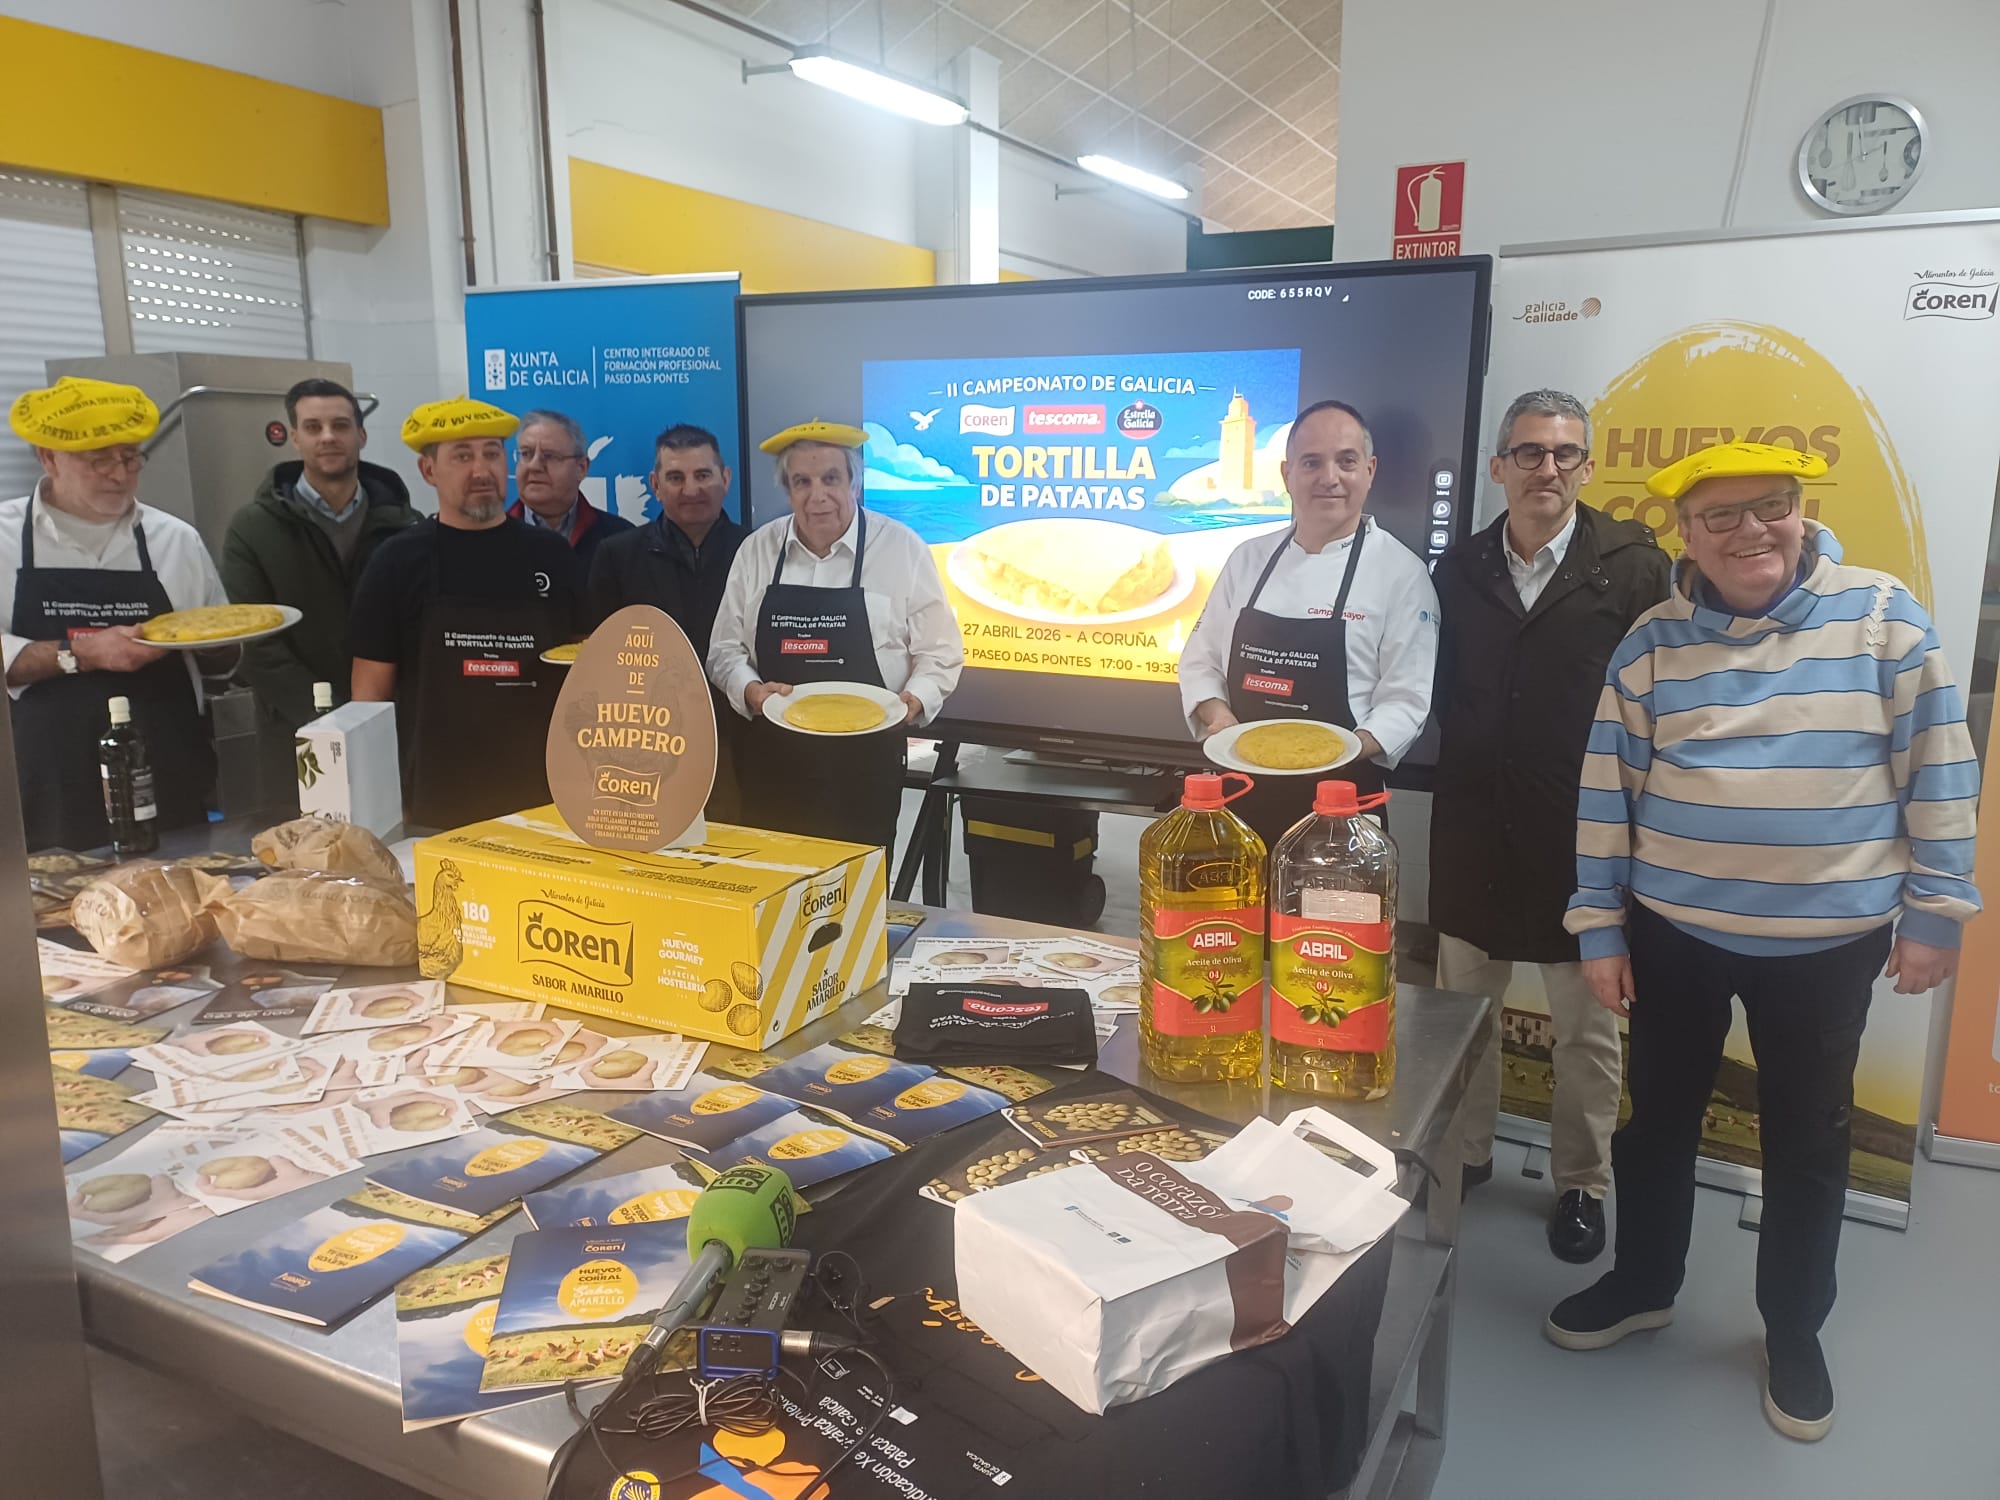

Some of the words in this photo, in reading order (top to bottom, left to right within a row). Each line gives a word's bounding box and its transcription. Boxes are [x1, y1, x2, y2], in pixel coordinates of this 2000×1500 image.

[1396, 241, 1456, 260] EXTINTOR
[1280, 286, 1332, 298] 655RQV
[1519, 301, 1566, 315] galicia
[1525, 311, 1578, 323] calidade
[510, 352, 558, 367] XUNTA
[604, 348, 639, 359] CENTRO
[641, 347, 695, 358] INTEGRADO
[697, 347, 711, 357] DE
[604, 358, 656, 371] FORMACIÓN
[658, 360, 722, 370] PROFESIONAL
[510, 371, 529, 386] DE
[533, 369, 589, 385] GALICIA
[605, 374, 631, 384] PASEO
[633, 374, 651, 384] DAS
[653, 373, 690, 384] PONTES
[947, 383, 958, 397] II
[963, 375, 1087, 396] CAMPEONATO
[1092, 376, 1115, 391] DE
[1120, 376, 1196, 395] GALICIA
[1124, 408, 1155, 419] Estrella
[1124, 418, 1154, 429] Galicia
[973, 446, 1156, 479] TORTILLA
[981, 484, 1016, 508] DE
[1021, 485, 1146, 511] PATATAS
[625, 632, 653, 648] AQUÍ
[963, 623, 980, 636] 27
[982, 625, 1022, 639] ABRIL
[1026, 628, 1061, 642] 2026
[1077, 631, 1088, 644] A
[1092, 629, 1158, 648] CORUÑA
[617, 653, 659, 667] SOMOS
[972, 648, 1011, 662] PASEO
[1014, 652, 1039, 664] DAS
[1041, 653, 1092, 668] PONTES
[1100, 658, 1133, 671] 17:00
[1289, 651, 1319, 660] GALICIA
[1285, 659, 1317, 668] PATATAS
[629, 672, 645, 685] DE
[597, 703, 670, 727] HUEVO
[578, 728, 685, 756] CAMPERO
[462, 901, 490, 923] 180
[662, 938, 699, 954] HUEVOS
[1192, 931, 1237, 948] ABRIL
[658, 949, 704, 966] GOURMET
[1300, 941, 1348, 960] ABRIL
[1186, 957, 1210, 966] Aceite
[1212, 957, 1221, 965] de
[1222, 955, 1242, 965] Oliva
[1293, 965, 1318, 976] Aceite
[1319, 968, 1330, 976] de
[1331, 969, 1353, 979] Oliva
[533, 974, 567, 992] SABOR
[571, 985, 624, 1003] AMARILLO
[812, 973, 839, 996] SABOR
[806, 981, 846, 1012] AMARILLO
[1136, 1162, 1153, 1172] O
[578, 1274, 622, 1282] CORRAL
[579, 1267, 622, 1275] HUEVOS
[573, 1285, 624, 1296] Sabor
[569, 1296, 625, 1308] AMARILLO
[871, 1436, 916, 1469] Pataca
[966, 1451, 990, 1470] GALICIA
[972, 1463, 995, 1478] XUNTA
[989, 1465, 1000, 1475] DE
